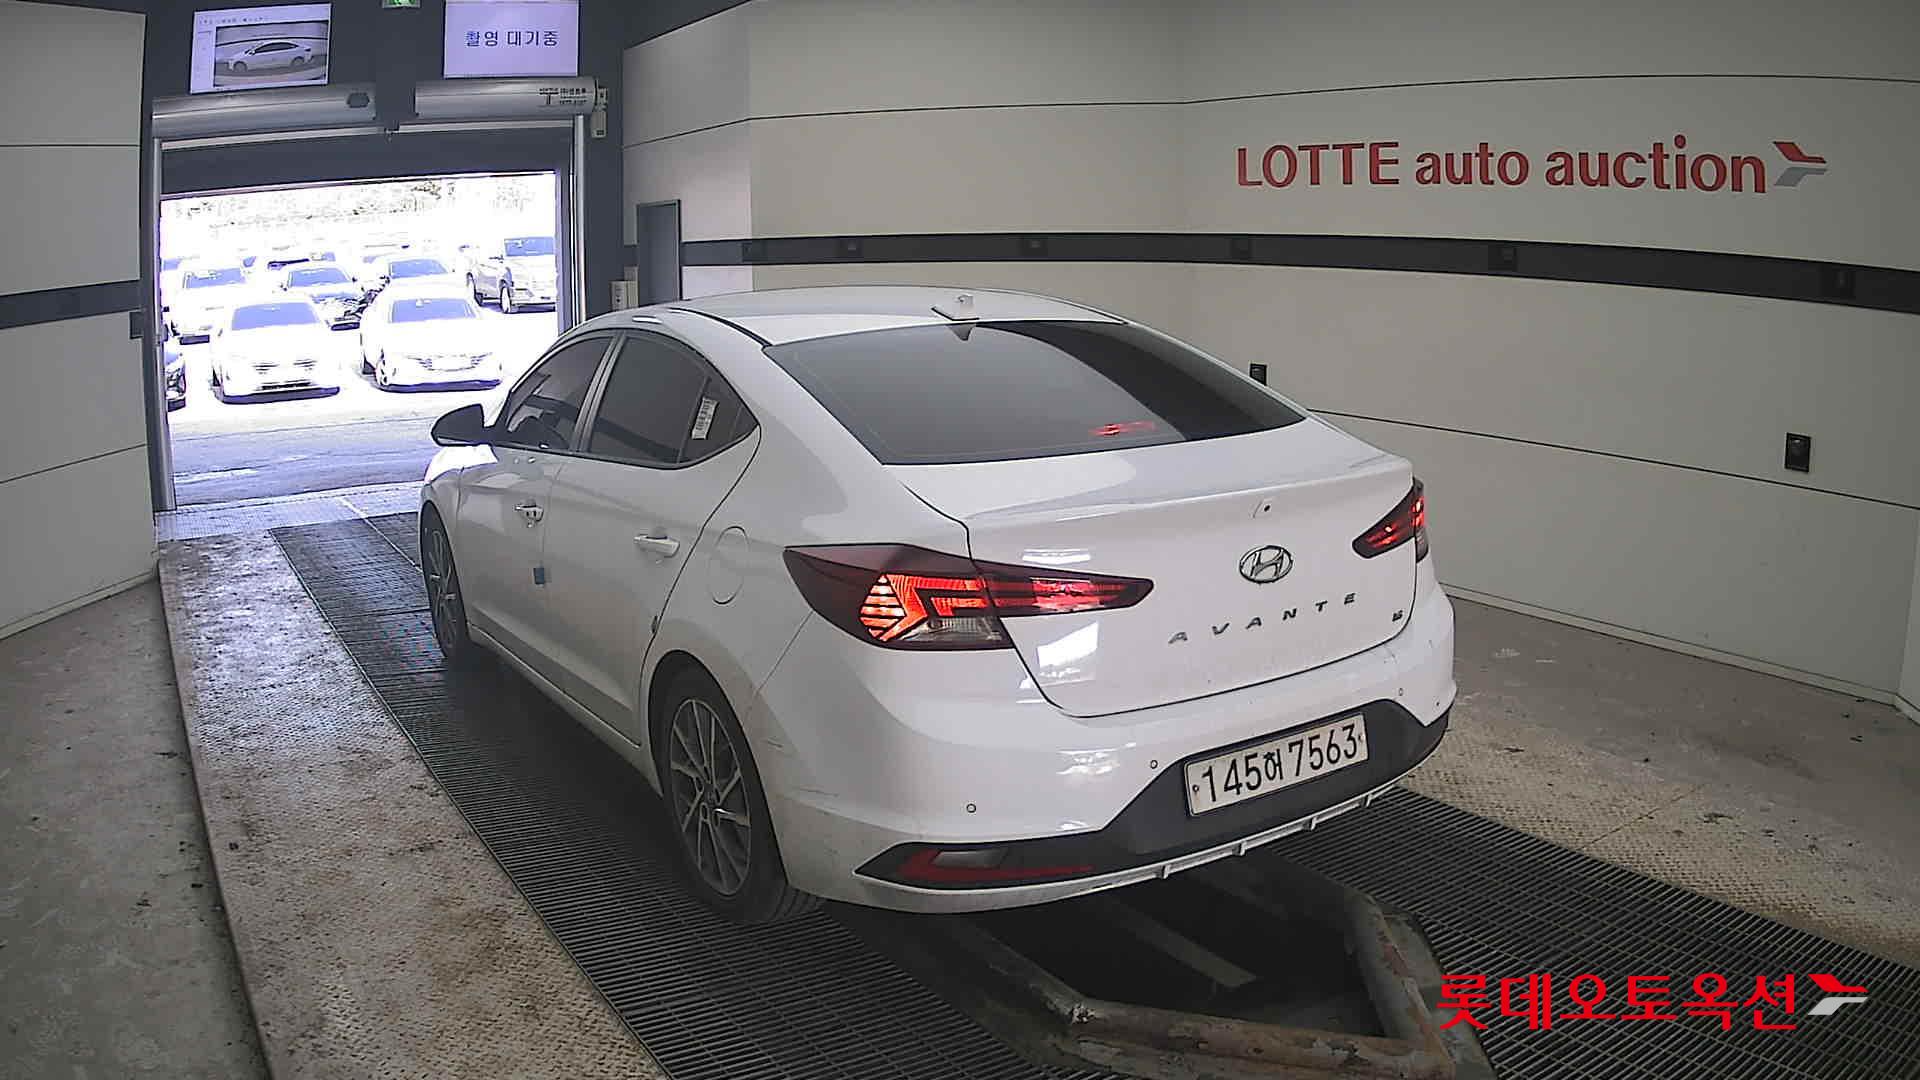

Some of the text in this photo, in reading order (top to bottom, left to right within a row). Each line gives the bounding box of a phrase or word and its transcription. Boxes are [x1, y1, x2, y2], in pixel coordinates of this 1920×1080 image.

[506, 31, 558, 47] 대기중
[1237, 134, 1767, 194] LOTTE auto auction
[1168, 592, 1356, 644] AVANTE
